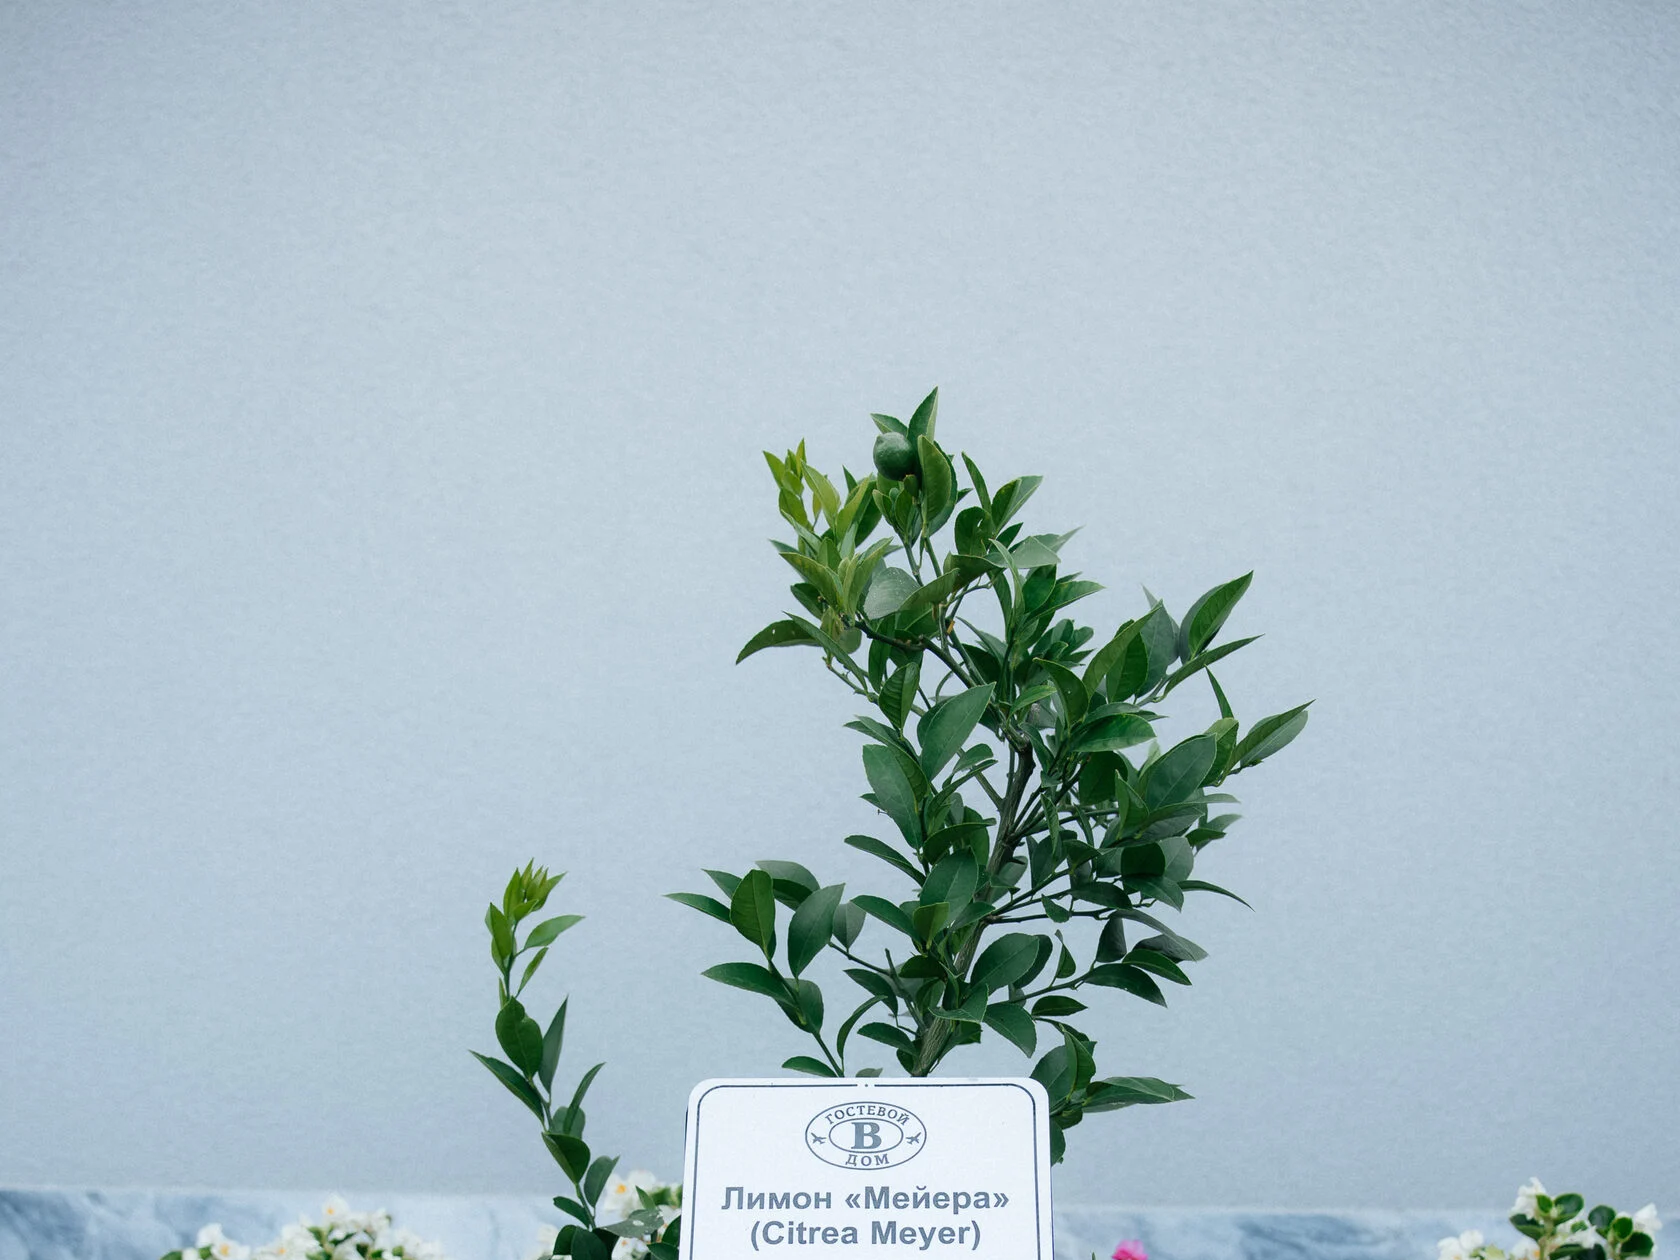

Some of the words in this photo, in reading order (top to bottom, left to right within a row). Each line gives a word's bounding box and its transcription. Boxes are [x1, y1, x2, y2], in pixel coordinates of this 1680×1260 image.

[824, 1105, 910, 1126] ГОСТЕВОЙ
[845, 1153, 890, 1167] ДОМ
[720, 1186, 832, 1210] Лимон
[845, 1185, 1010, 1215] «Мейера»
[751, 1220, 858, 1251] (Citrea
[871, 1220, 981, 1251] Meyer)
